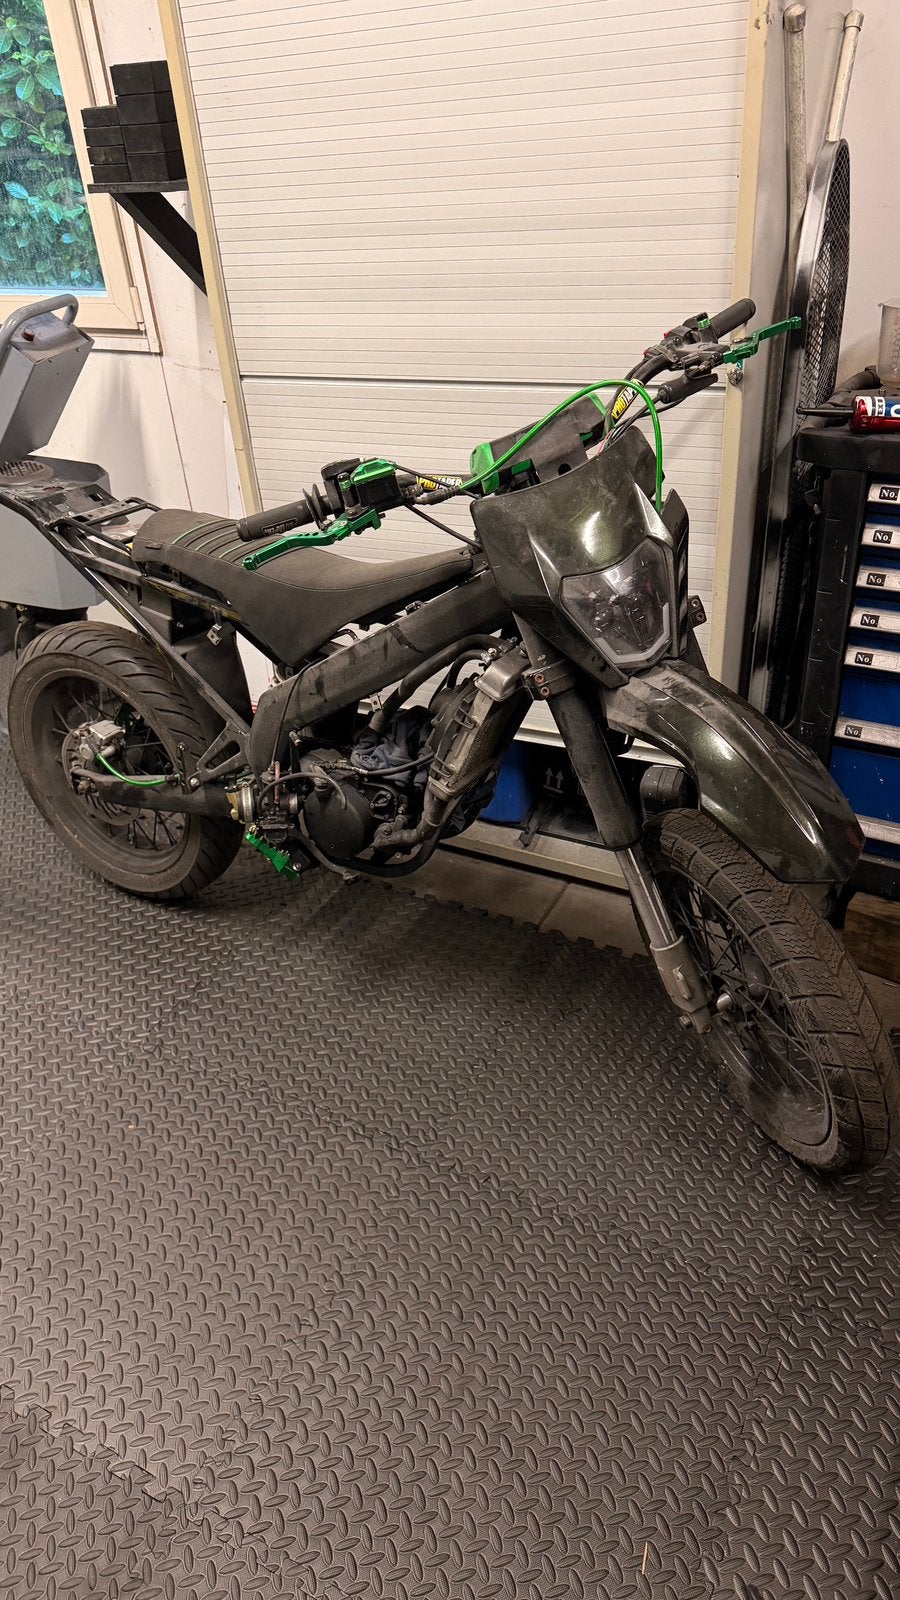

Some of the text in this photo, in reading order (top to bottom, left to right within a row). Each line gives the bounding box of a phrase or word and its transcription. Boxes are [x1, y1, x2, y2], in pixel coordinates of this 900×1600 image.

[880, 488, 898, 499] No.
[874, 531, 891, 542] No.
[868, 574, 885, 585] No.
[861, 615, 878, 626] No.
[855, 653, 872, 664] No.
[845, 726, 861, 737] No.
